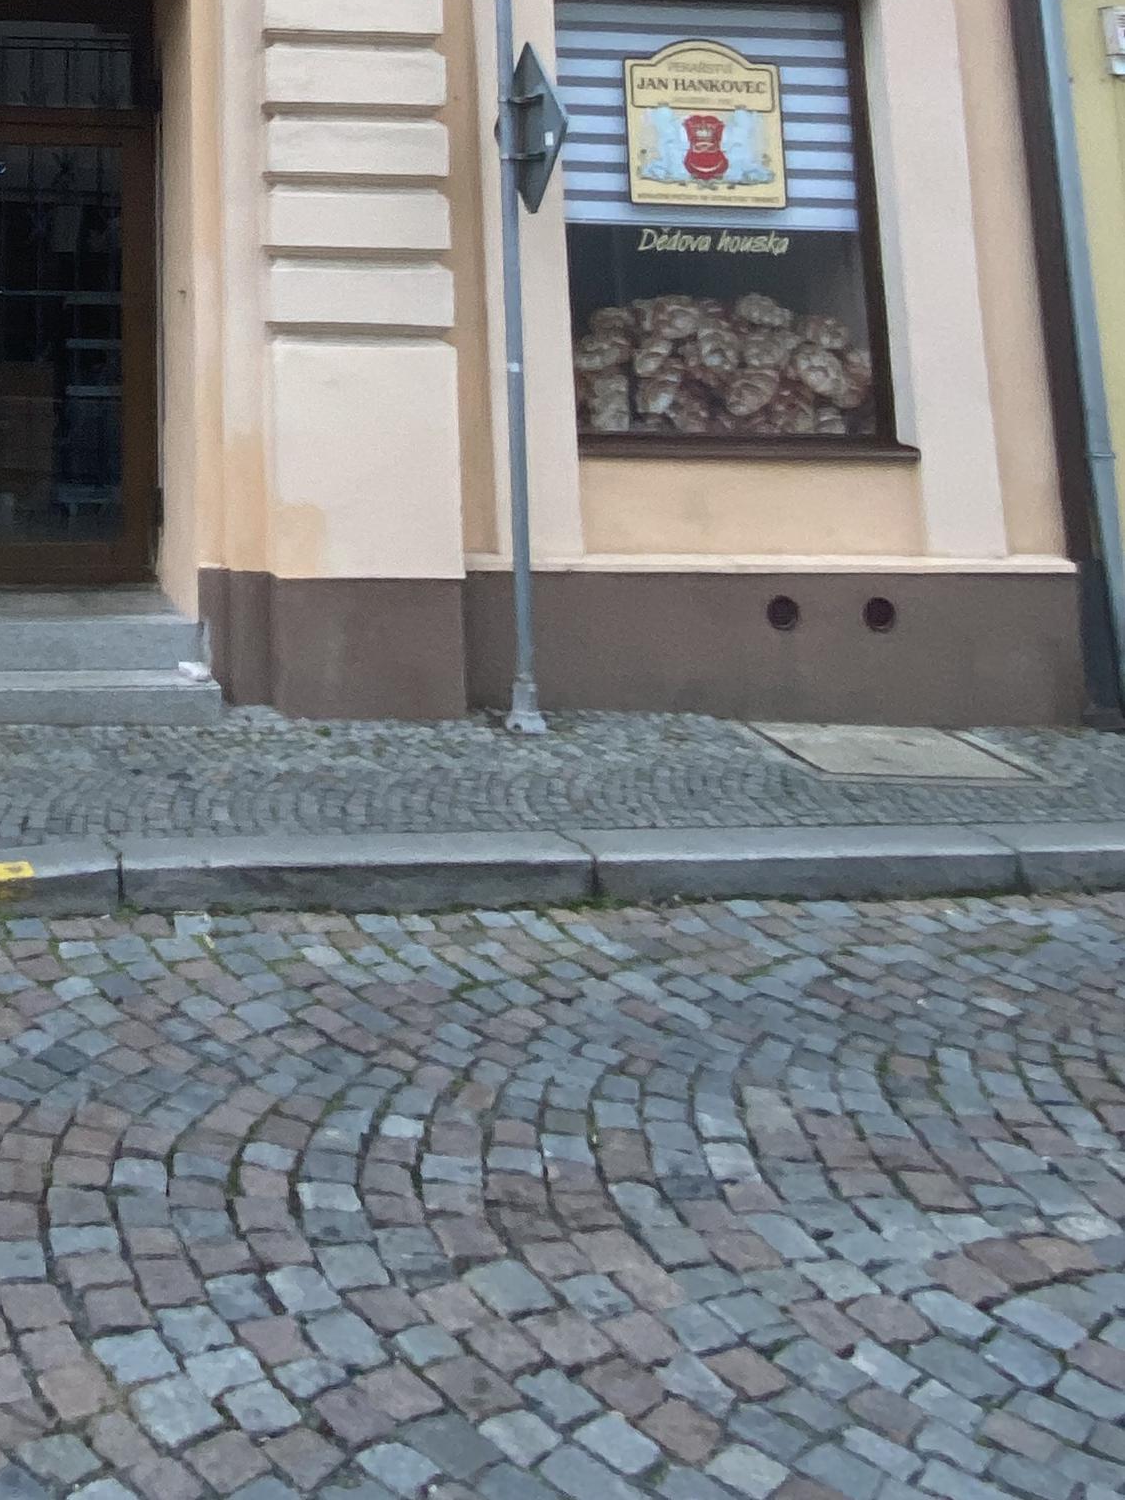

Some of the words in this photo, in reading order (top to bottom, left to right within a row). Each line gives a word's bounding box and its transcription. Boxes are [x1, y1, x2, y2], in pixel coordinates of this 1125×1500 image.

[637, 76, 669, 90] JAN
[674, 78, 767, 94] HANKOVEC
[638, 228, 711, 252] Dědova
[717, 230, 789, 255] houska
